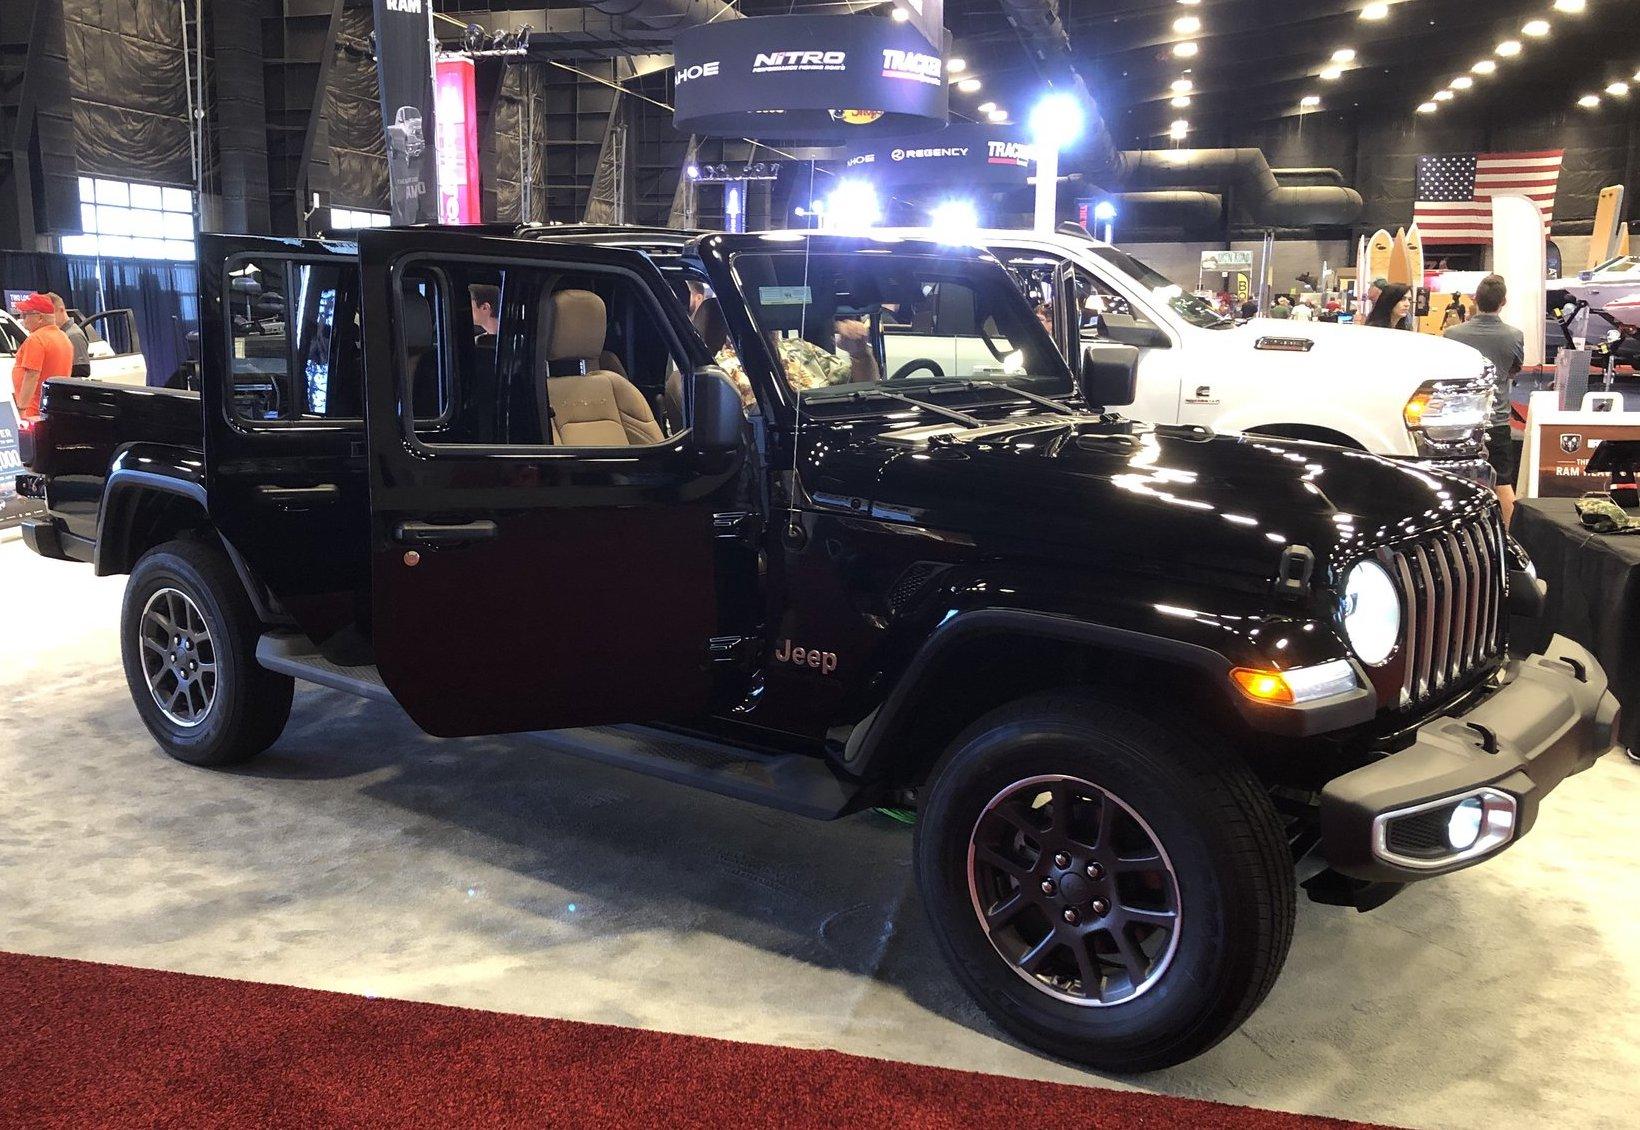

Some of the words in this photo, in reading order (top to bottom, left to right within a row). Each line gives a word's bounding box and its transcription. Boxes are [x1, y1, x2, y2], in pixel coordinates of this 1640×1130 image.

[386, 0, 422, 14] RAM
[753, 51, 846, 67] NITRO
[906, 147, 969, 159] REGENCY
[1556, 466, 1580, 477] RAM
[775, 639, 838, 675] Jeep
